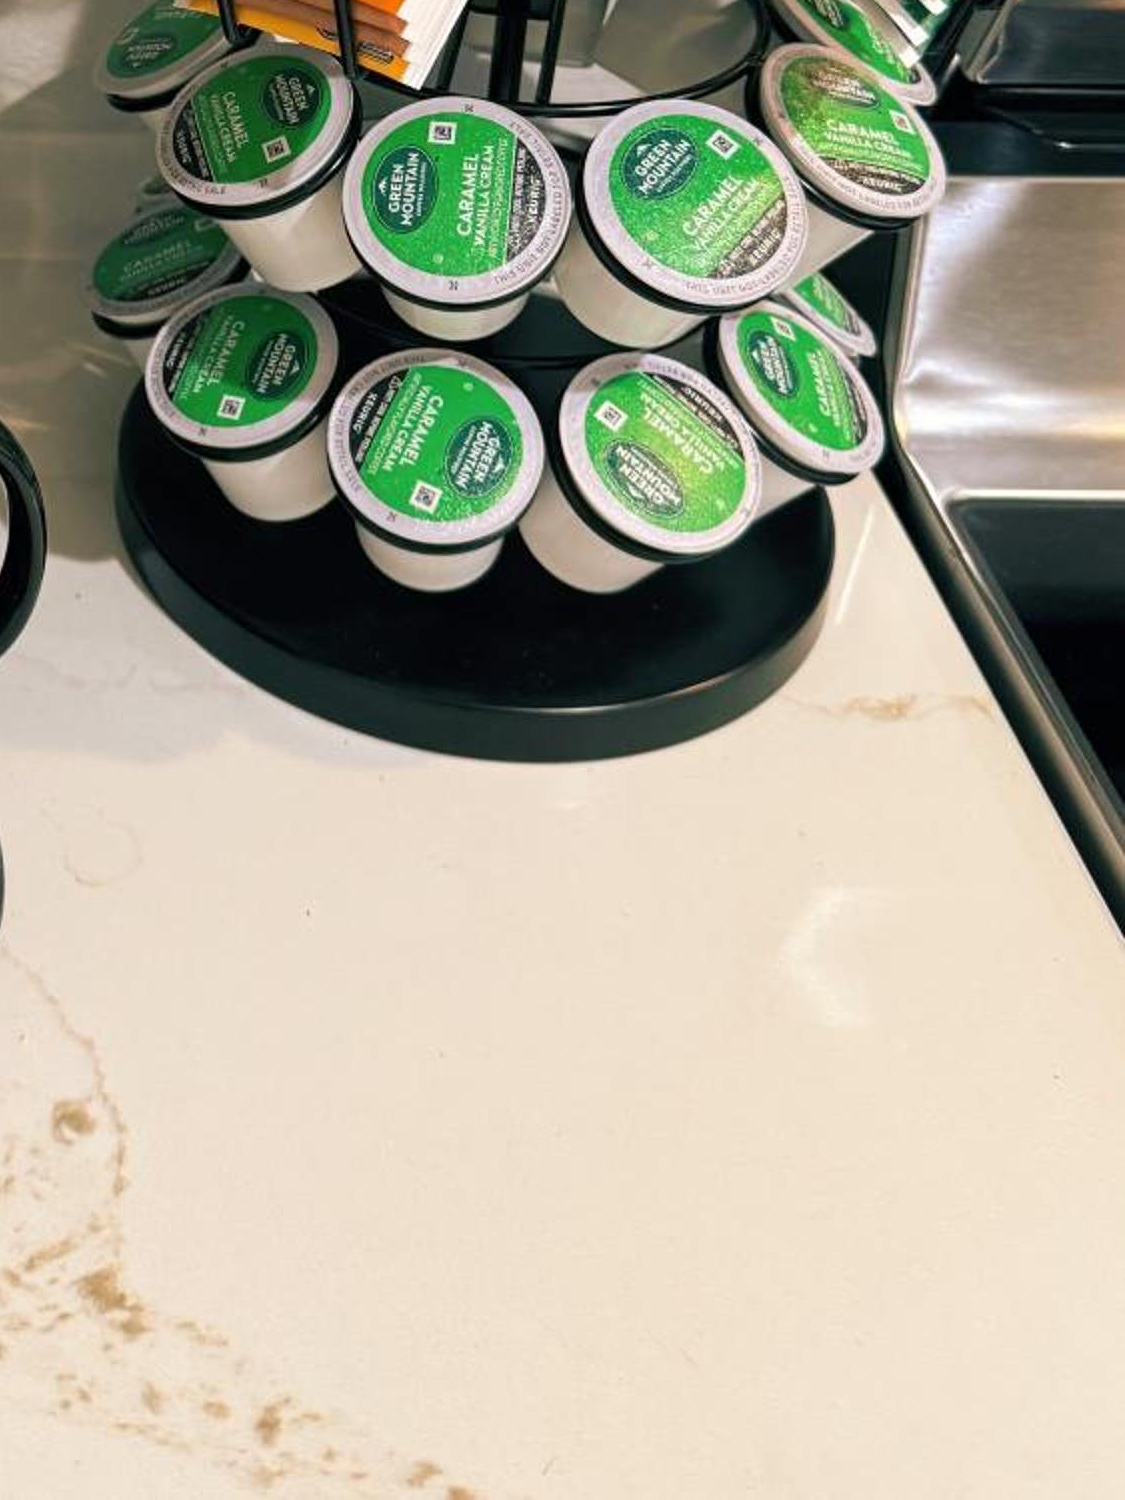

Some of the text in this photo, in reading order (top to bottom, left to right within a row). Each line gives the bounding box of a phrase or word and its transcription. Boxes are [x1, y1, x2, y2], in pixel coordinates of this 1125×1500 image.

[220, 90, 251, 150] CARAMEL
[387, 163, 403, 212] GREEN
[634, 138, 674, 177] GREEN
[637, 138, 692, 195] MOUNTAIN
[400, 151, 419, 226] MOUNTAIN
[455, 152, 479, 236] CARAMEL
[474, 144, 493, 245] VANILLA CREAM
[681, 174, 743, 237] CARAMEL
[206, 320, 246, 386] CARAMEL
[271, 344, 297, 386] GREEN
[398, 395, 445, 467] CARAMEL
[402, 385, 433, 429] VANILLA
[382, 429, 410, 473] CREAM
[454, 421, 494, 490] MOUNTAIN
[473, 437, 501, 484] GREEN
[643, 406, 714, 475] CARAMEL
[615, 445, 683, 505] MOUNTAIN
[618, 464, 665, 506] GREEN
